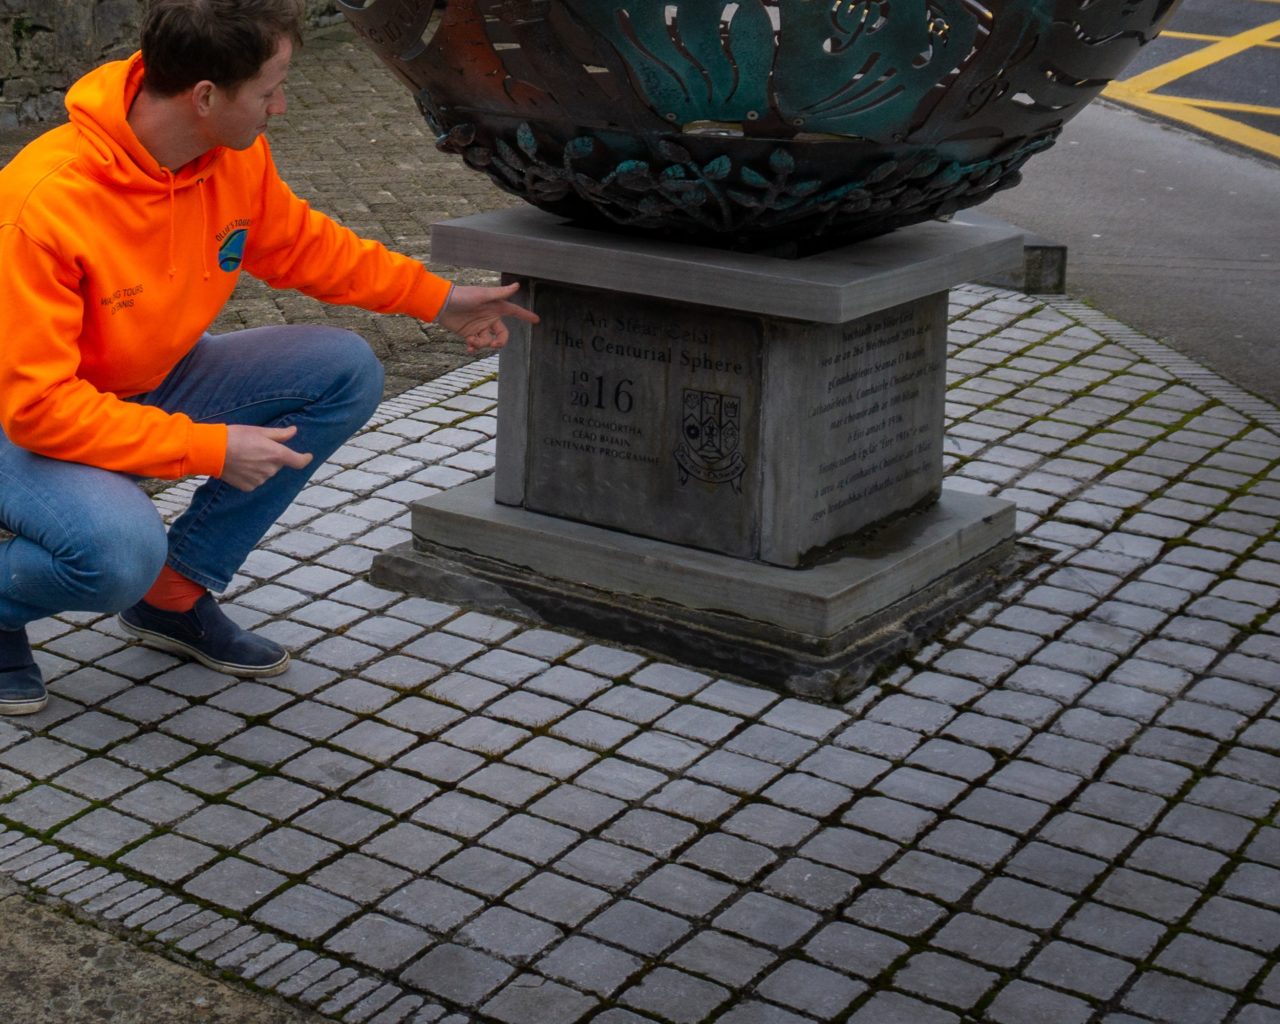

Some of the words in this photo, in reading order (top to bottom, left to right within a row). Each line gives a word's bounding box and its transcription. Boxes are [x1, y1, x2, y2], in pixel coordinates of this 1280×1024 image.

[554, 329, 584, 350] The
[591, 335, 673, 364] Centurial
[680, 350, 744, 375] Sphere
